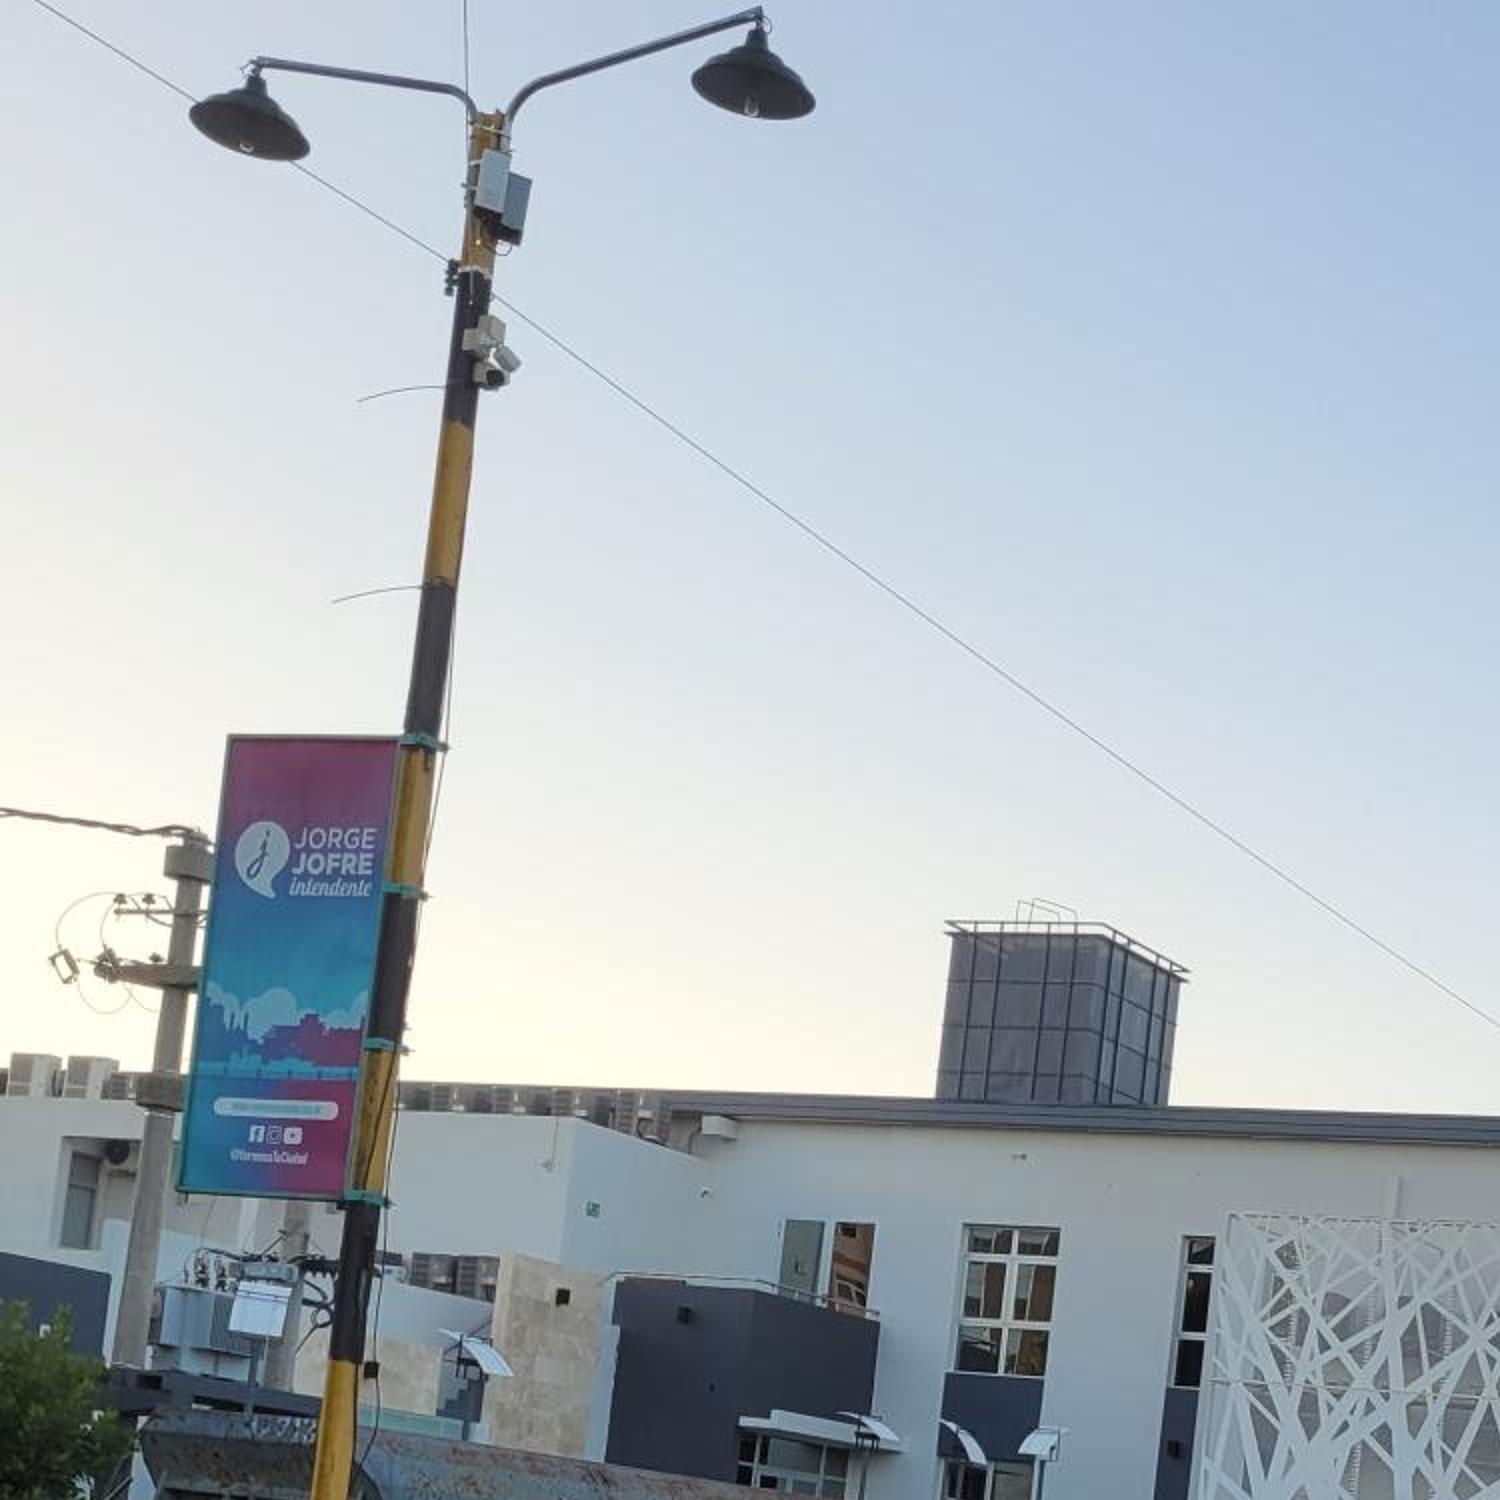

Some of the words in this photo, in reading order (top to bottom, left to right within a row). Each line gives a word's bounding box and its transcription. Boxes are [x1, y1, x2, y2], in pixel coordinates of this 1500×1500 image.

[294, 827, 377, 849] JORGE
[290, 852, 374, 875] JOFRE
[289, 877, 371, 896] intendente
